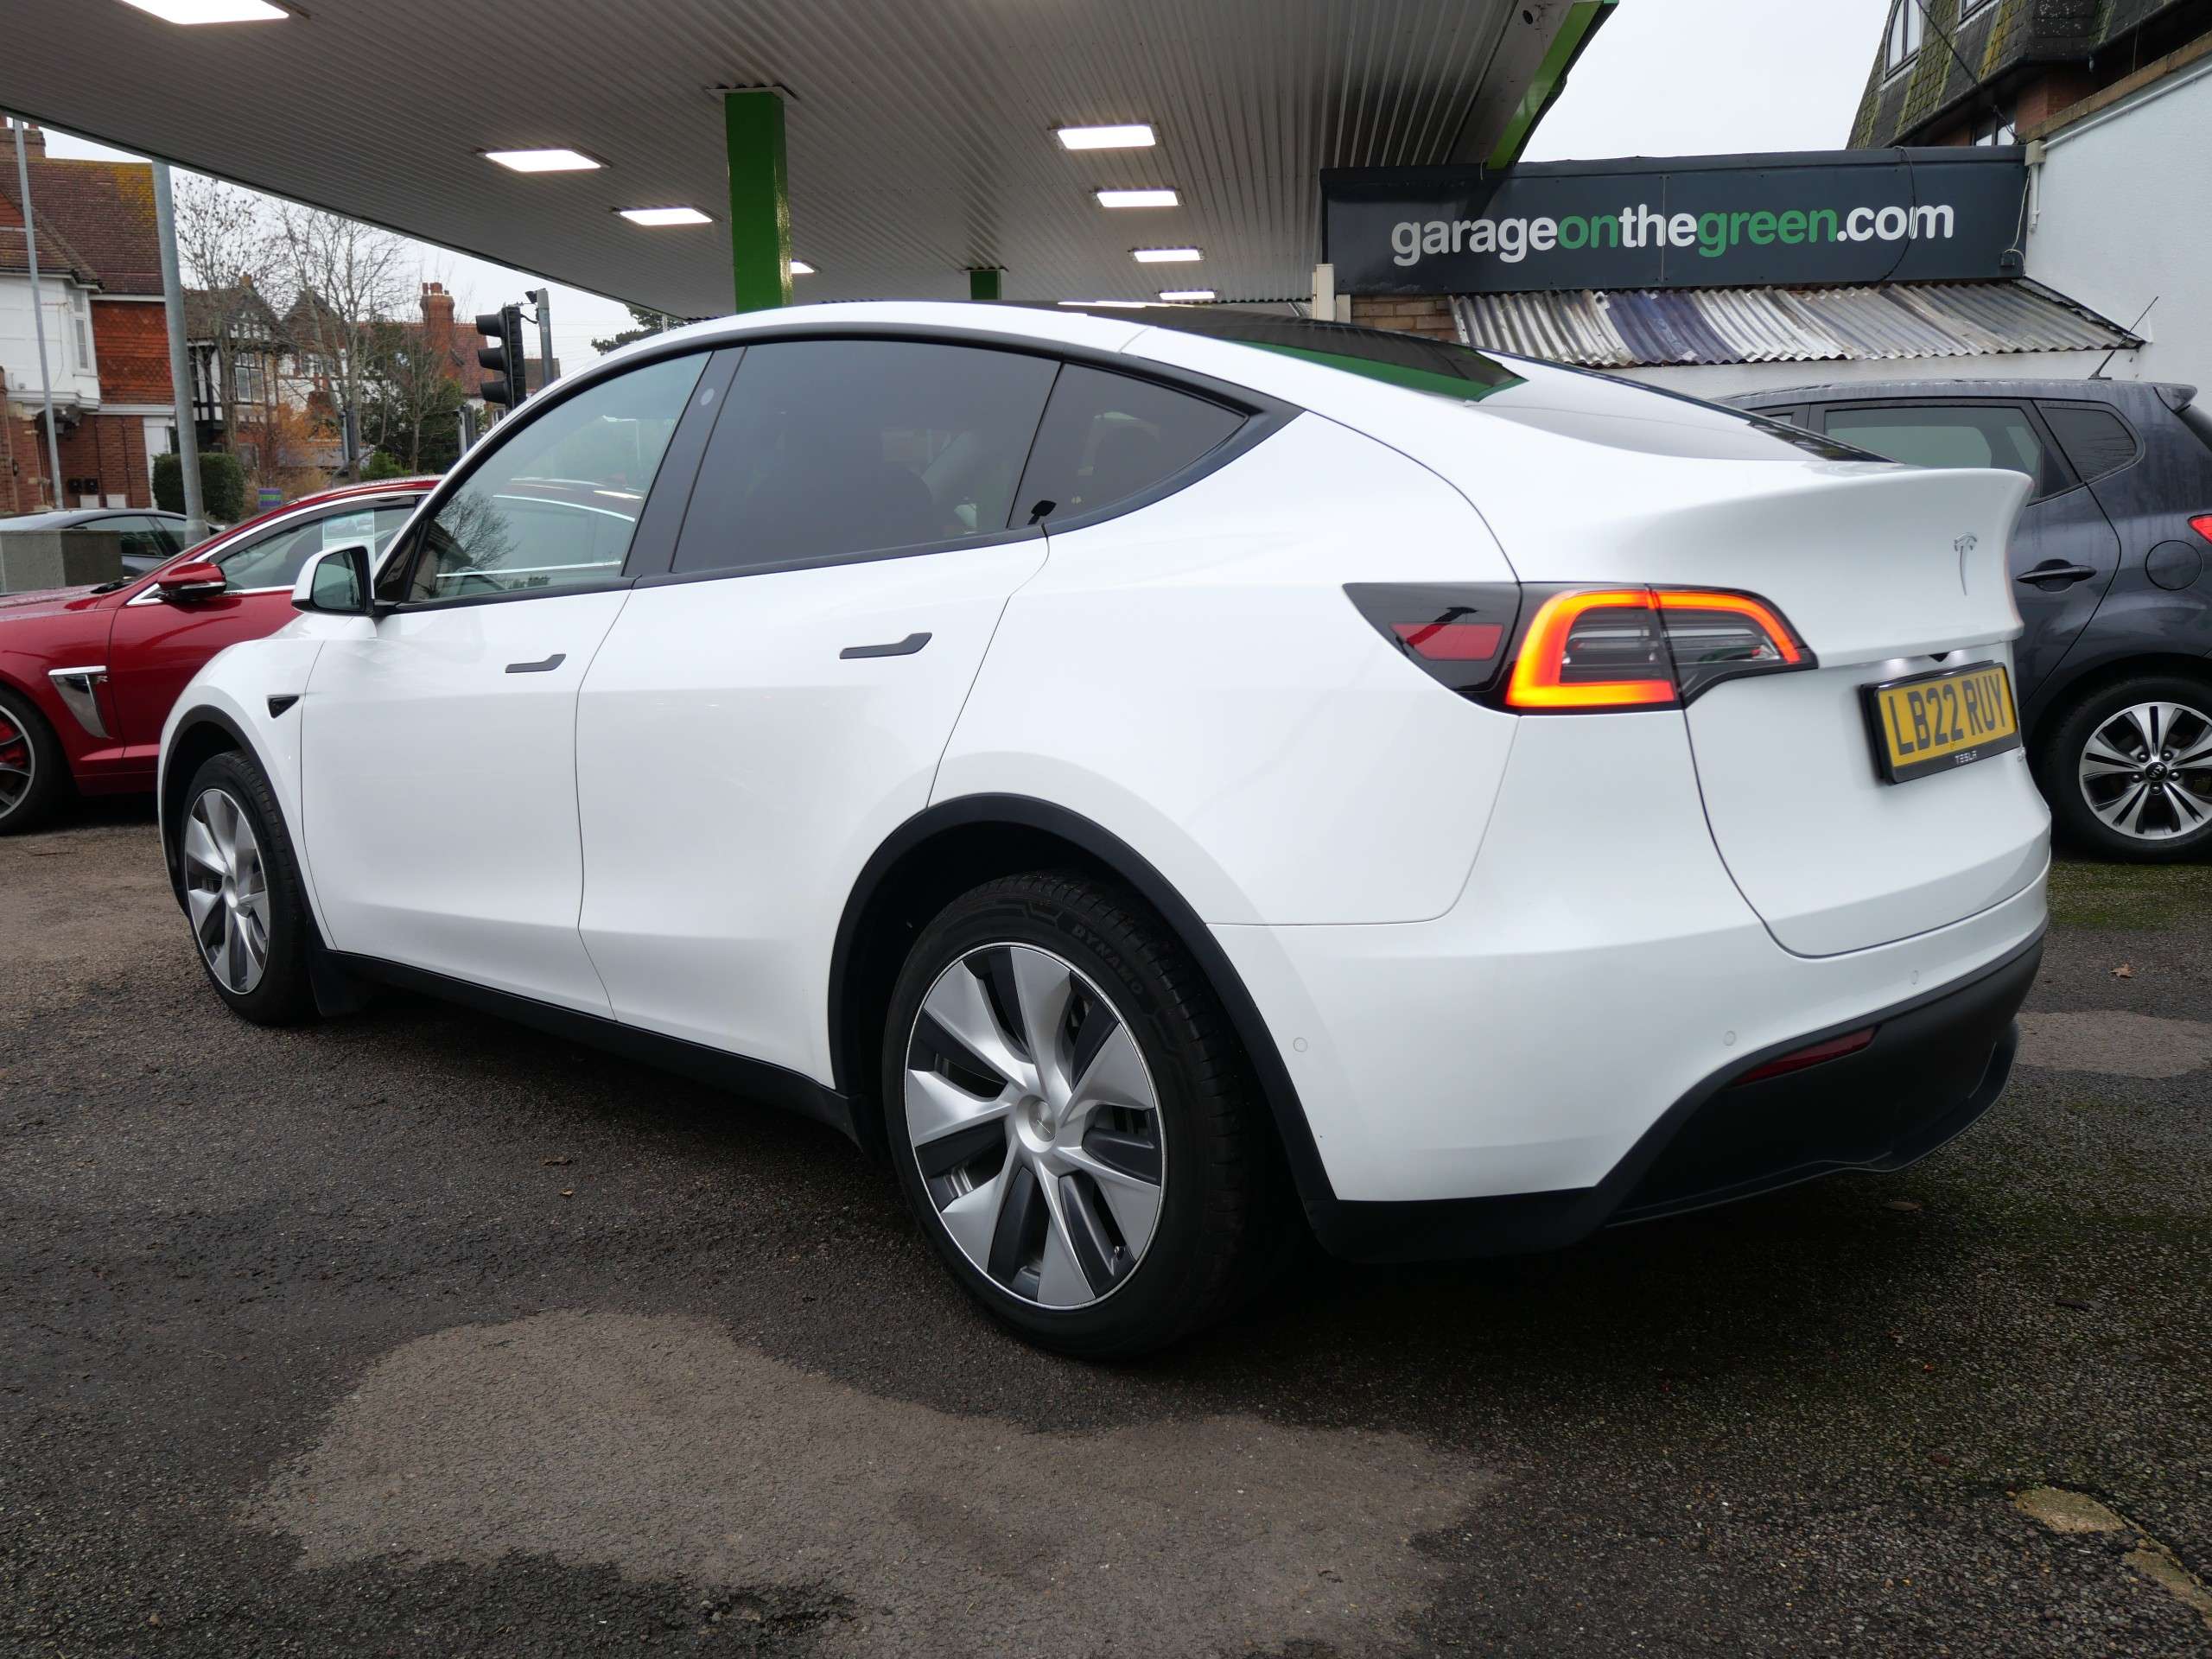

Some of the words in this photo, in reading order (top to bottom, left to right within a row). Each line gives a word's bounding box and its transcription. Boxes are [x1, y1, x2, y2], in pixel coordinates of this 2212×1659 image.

[1390, 204, 1955, 266] garageonthegreen.com
[1889, 684, 1964, 755] LB22
[1961, 674, 2006, 735] RUY
